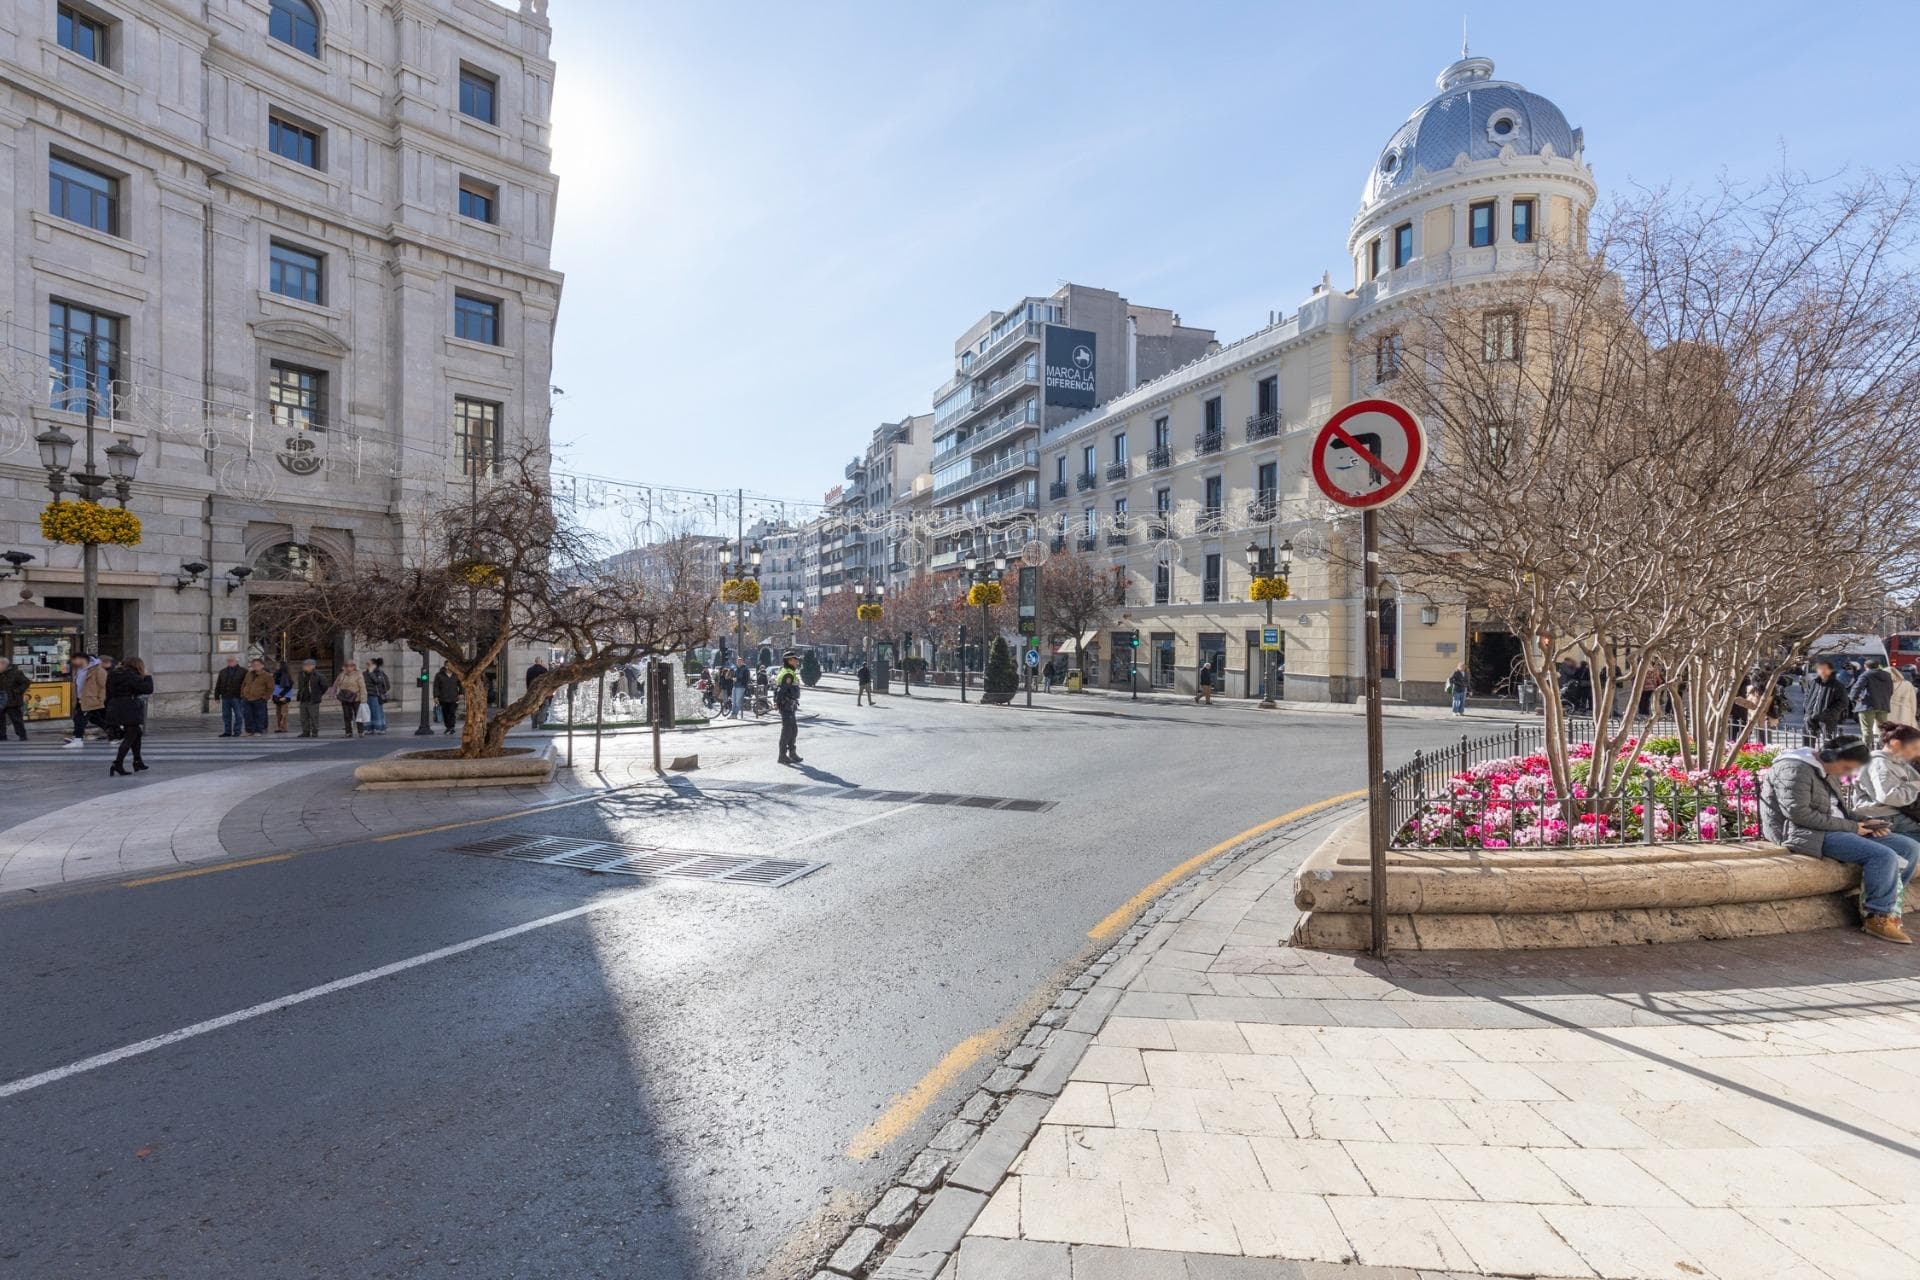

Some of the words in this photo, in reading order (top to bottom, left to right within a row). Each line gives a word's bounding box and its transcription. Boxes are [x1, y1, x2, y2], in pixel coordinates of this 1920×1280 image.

[1046, 365, 1080, 380] MARCA
[1083, 370, 1095, 383] LA
[1046, 377, 1095, 392] DIFERENCIA
